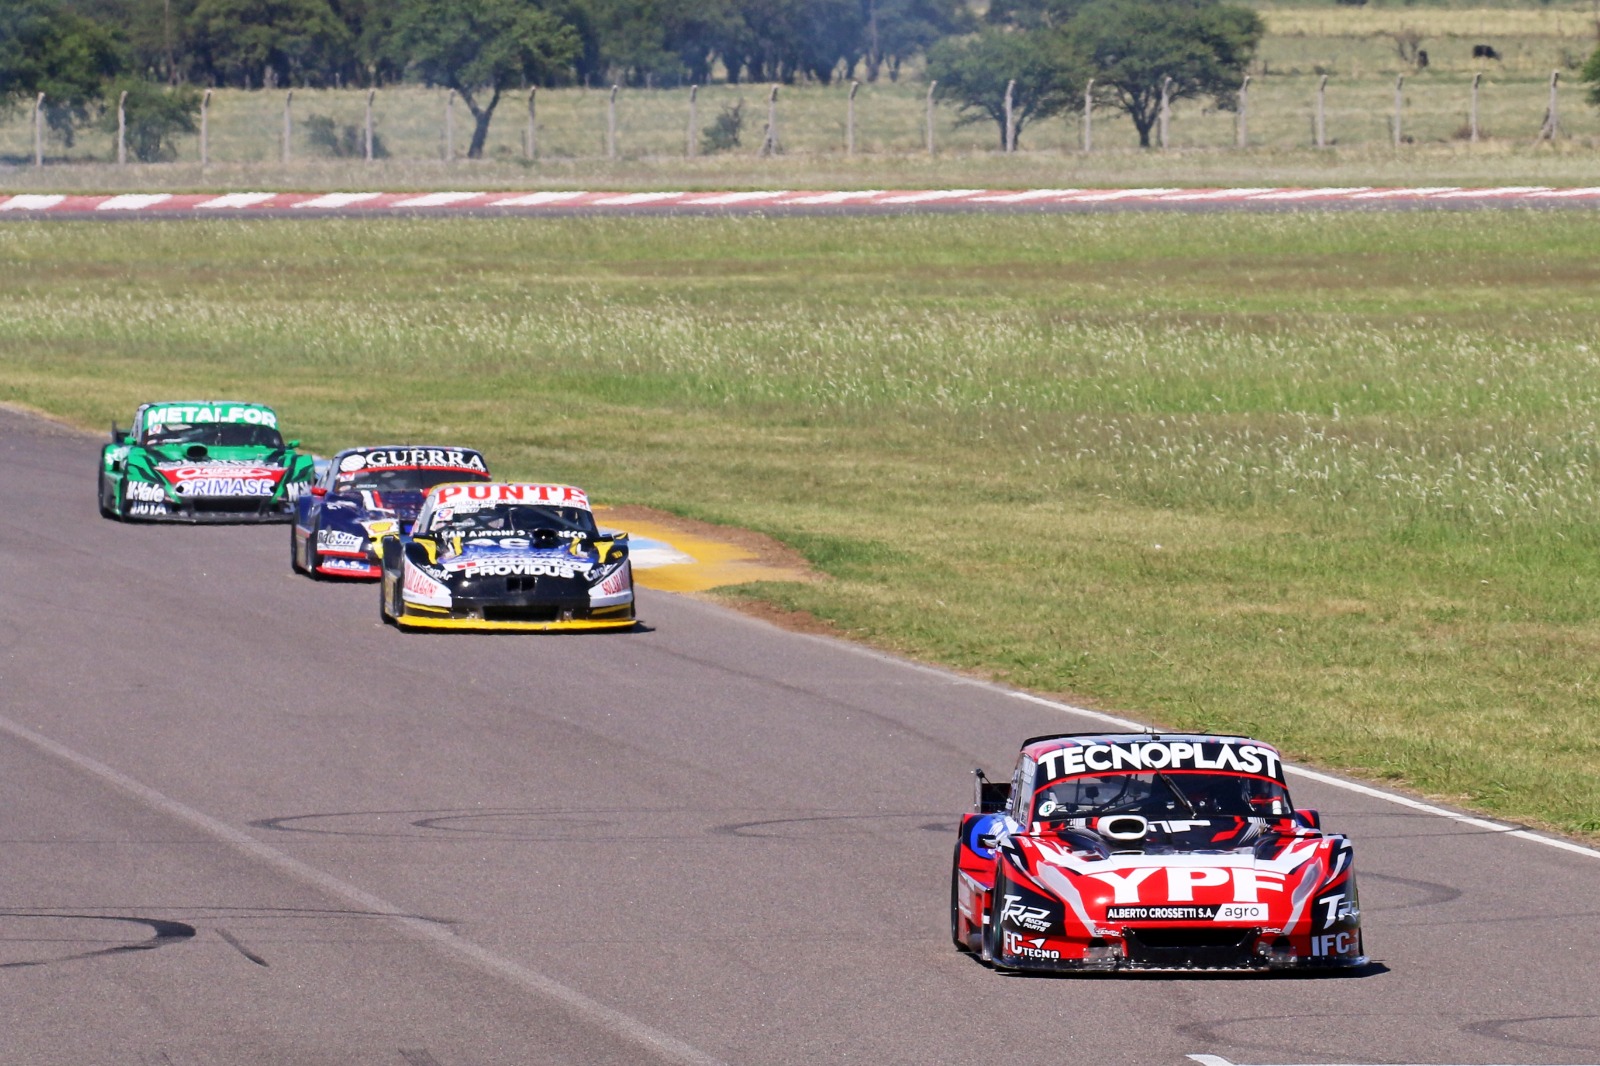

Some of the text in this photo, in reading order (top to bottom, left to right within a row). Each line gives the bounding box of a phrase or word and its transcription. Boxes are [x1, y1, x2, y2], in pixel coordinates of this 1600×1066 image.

[147, 407, 276, 428] METALFOR
[365, 450, 485, 469] GUERRA
[437, 485, 587, 505] PUNTE
[558, 531, 588, 539] RECO
[464, 564, 575, 579] PROVIDUS
[1038, 742, 1281, 781] TECNOPLAST
[1086, 867, 1286, 904] YPF
[1107, 907, 1215, 919] ALBERTO CROSSETTI S.A.
[1224, 906, 1260, 918] agro
[1022, 922, 1047, 932] PARTS
[1022, 947, 1060, 959] TECNO
[1311, 932, 1351, 957] IFC
